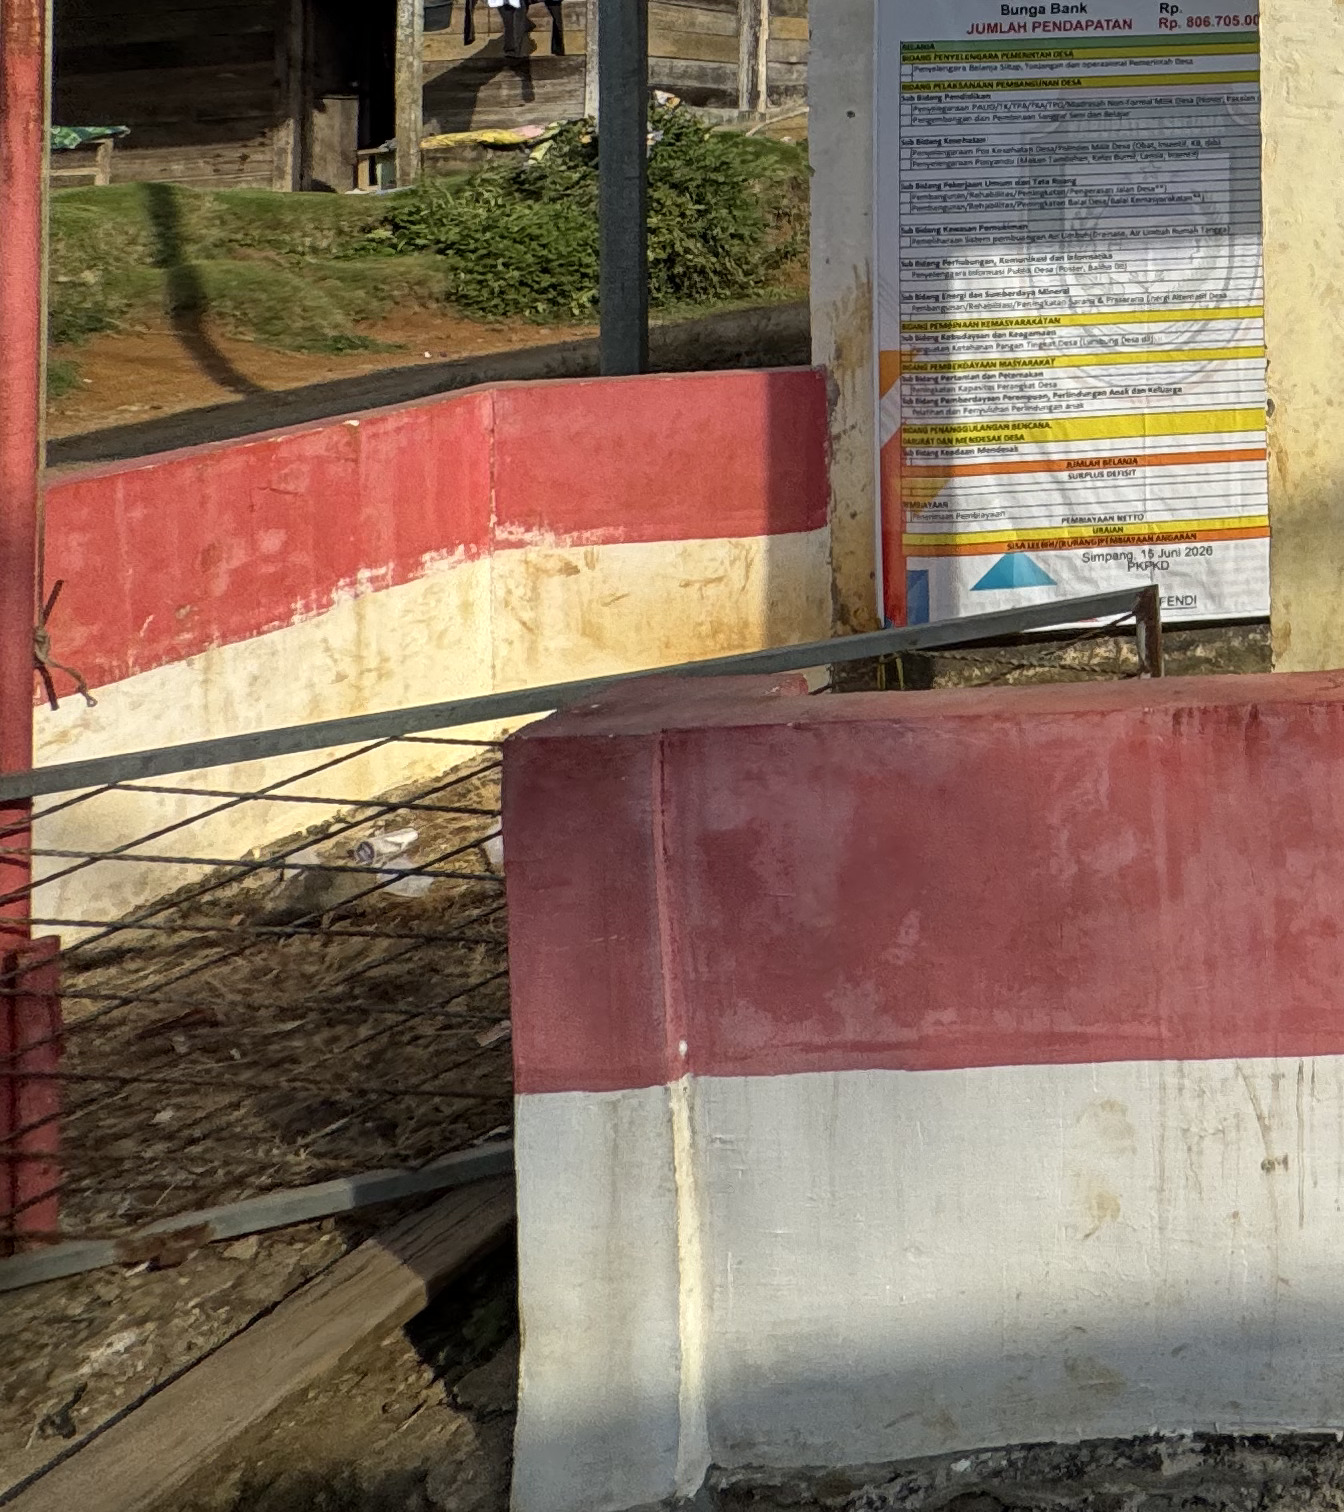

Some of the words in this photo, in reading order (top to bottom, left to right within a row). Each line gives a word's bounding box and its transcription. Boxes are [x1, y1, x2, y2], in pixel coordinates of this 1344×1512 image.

[1000, 3, 1046, 18] Bunga
[1050, 2, 1088, 15] Bank
[1159, 2, 1183, 16] Rp.
[966, 21, 1027, 35] JUMLAH
[1031, 18, 1133, 33] PENDAPATAN
[1158, 17, 1182, 31] Rp.
[1053, 50, 1073, 58] DESA
[937, 437, 953, 445] DAN
[1003, 434, 1025, 442] DESA
[1116, 513, 1144, 523] NETTO
[1082, 550, 1137, 564] Simpang,
[1158, 547, 1181, 558] Juni
[1127, 560, 1170, 572] PKPKD
